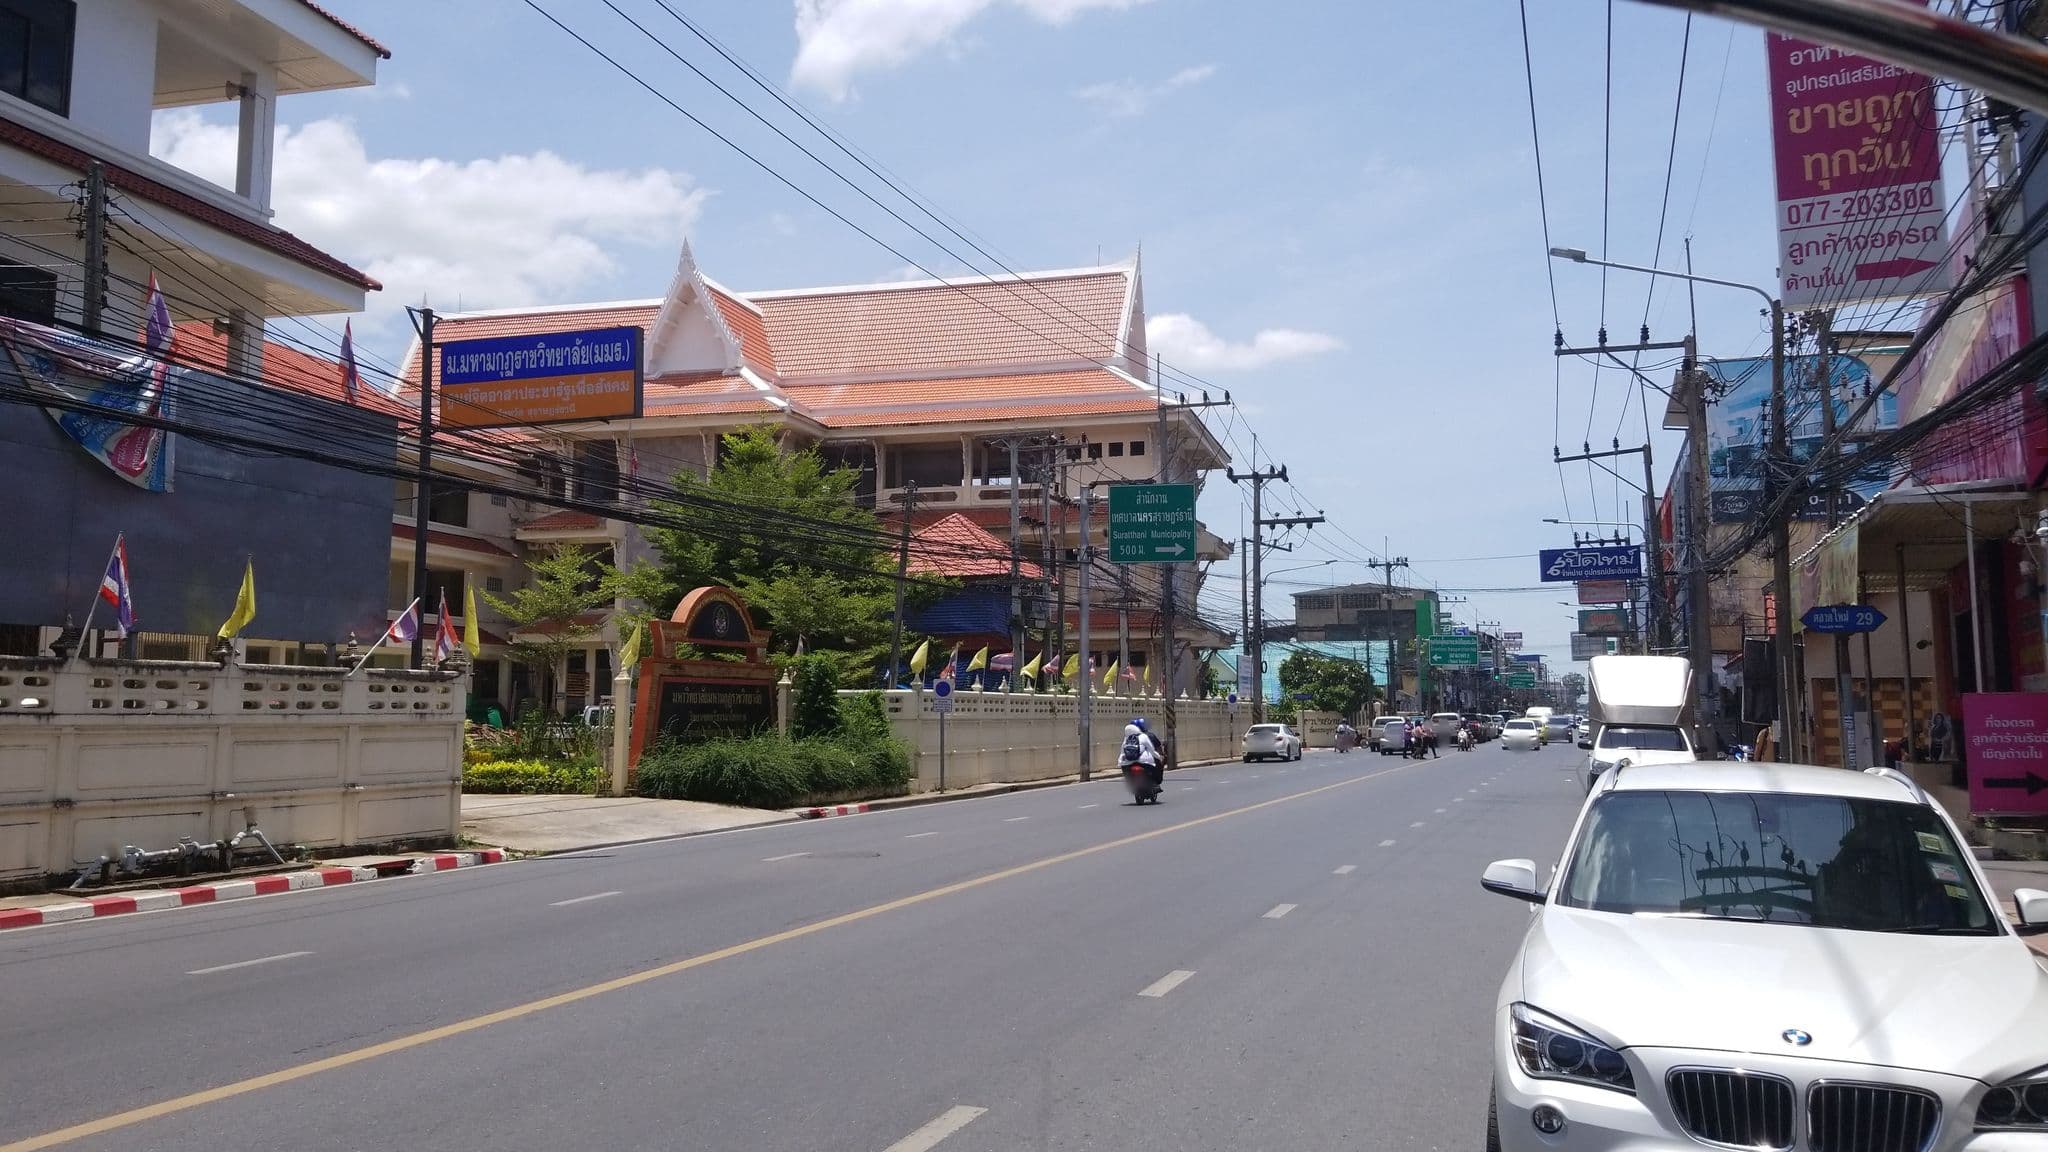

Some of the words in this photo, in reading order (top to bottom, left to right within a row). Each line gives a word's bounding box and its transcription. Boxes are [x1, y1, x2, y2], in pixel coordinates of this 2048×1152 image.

[1787, 90, 1921, 134] ขายถูก
[1803, 136, 1913, 191] ทุกวัน
[1787, 186, 1934, 226] 077-203300
[1788, 224, 1939, 266] ลูกค้าจอดรถ
[1786, 266, 1845, 292] ด้านใน
[1136, 490, 1168, 505] สำนักงาน
[1111, 507, 1193, 526] เทศบาลนครสุราษฎร์ธานี
[1112, 530, 1147, 540] Suratthani
[1150, 530, 1192, 541] Municipality
[1119, 545, 1137, 555] 500
[1856, 612, 1874, 626] 29
[1985, 714, 2035, 728] ที่จอดรถ
[1982, 746, 2043, 760] เชิญด้านใน
